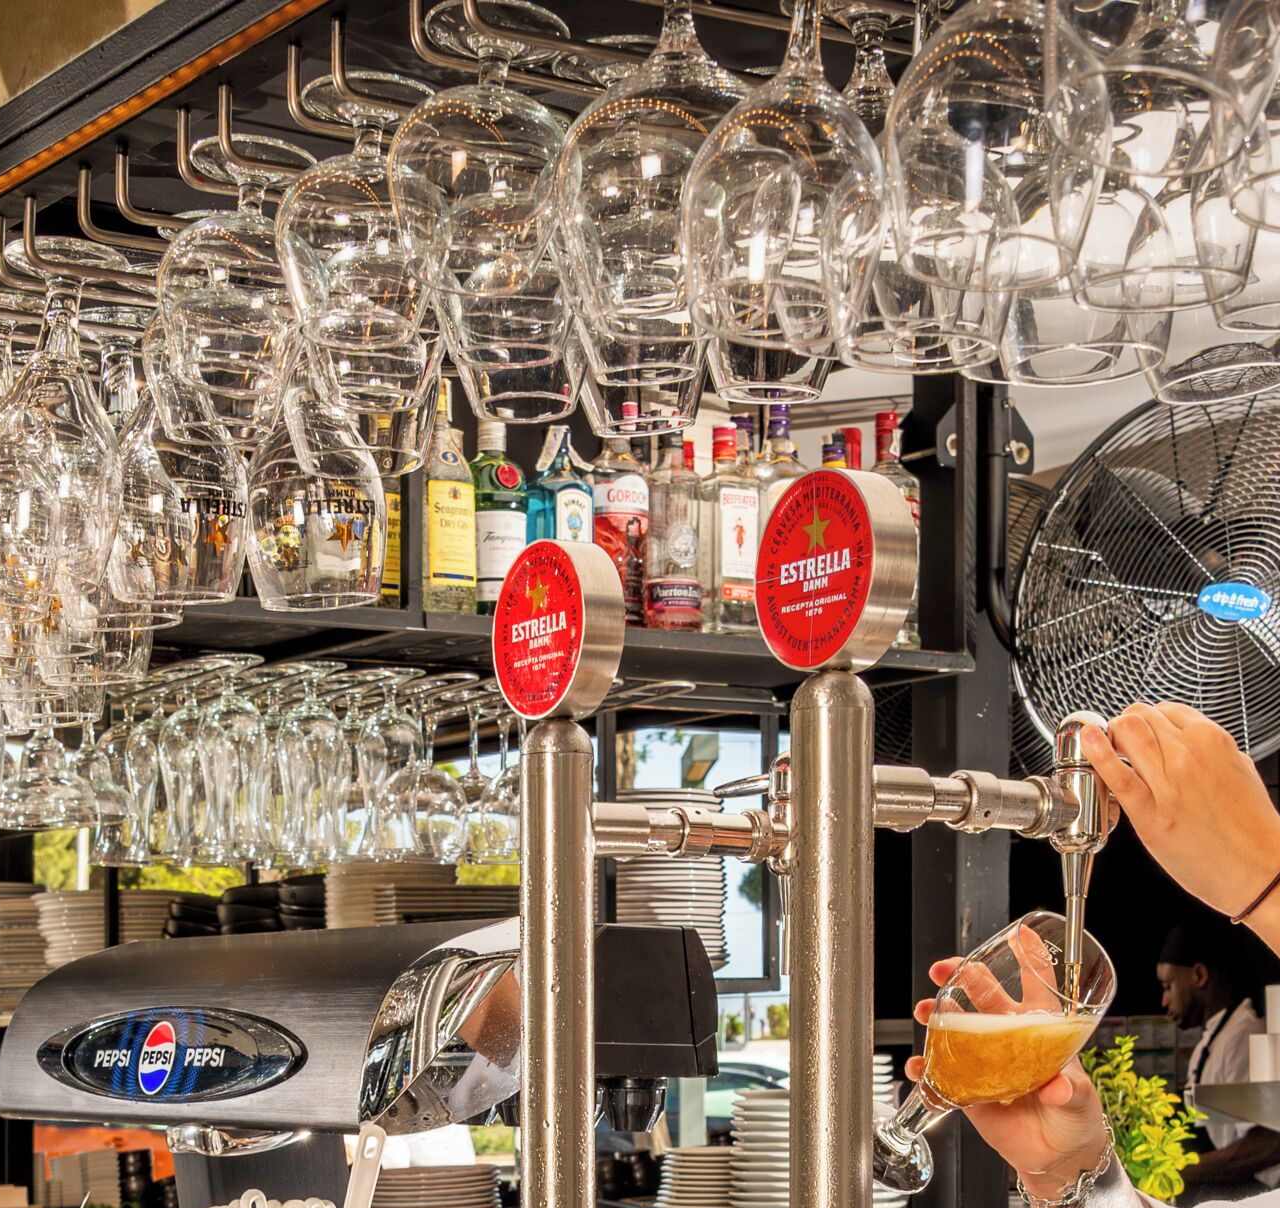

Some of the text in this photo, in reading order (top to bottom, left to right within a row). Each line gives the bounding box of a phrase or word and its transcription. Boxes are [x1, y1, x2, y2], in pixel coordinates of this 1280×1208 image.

[772, 499, 801, 556] CERVESA
[780, 548, 850, 585] ESTRELLA
[803, 576, 828, 592] DAMM
[781, 592, 847, 614] RECEPTA ORIGINAL
[844, 575, 864, 618] DAMM
[805, 607, 824, 617] 1876
[512, 611, 567, 644] ESTRELLA
[767, 596, 846, 651] AUGUST KUENTZMANN
[529, 635, 550, 650] DAMM
[513, 650, 565, 669] RECEPTA ORIGINAL
[532, 662, 546, 672] 1876
[94, 1050, 132, 1068] PEPSI
[141, 1050, 172, 1065] PEPSI
[184, 1047, 226, 1067] PEPSI
